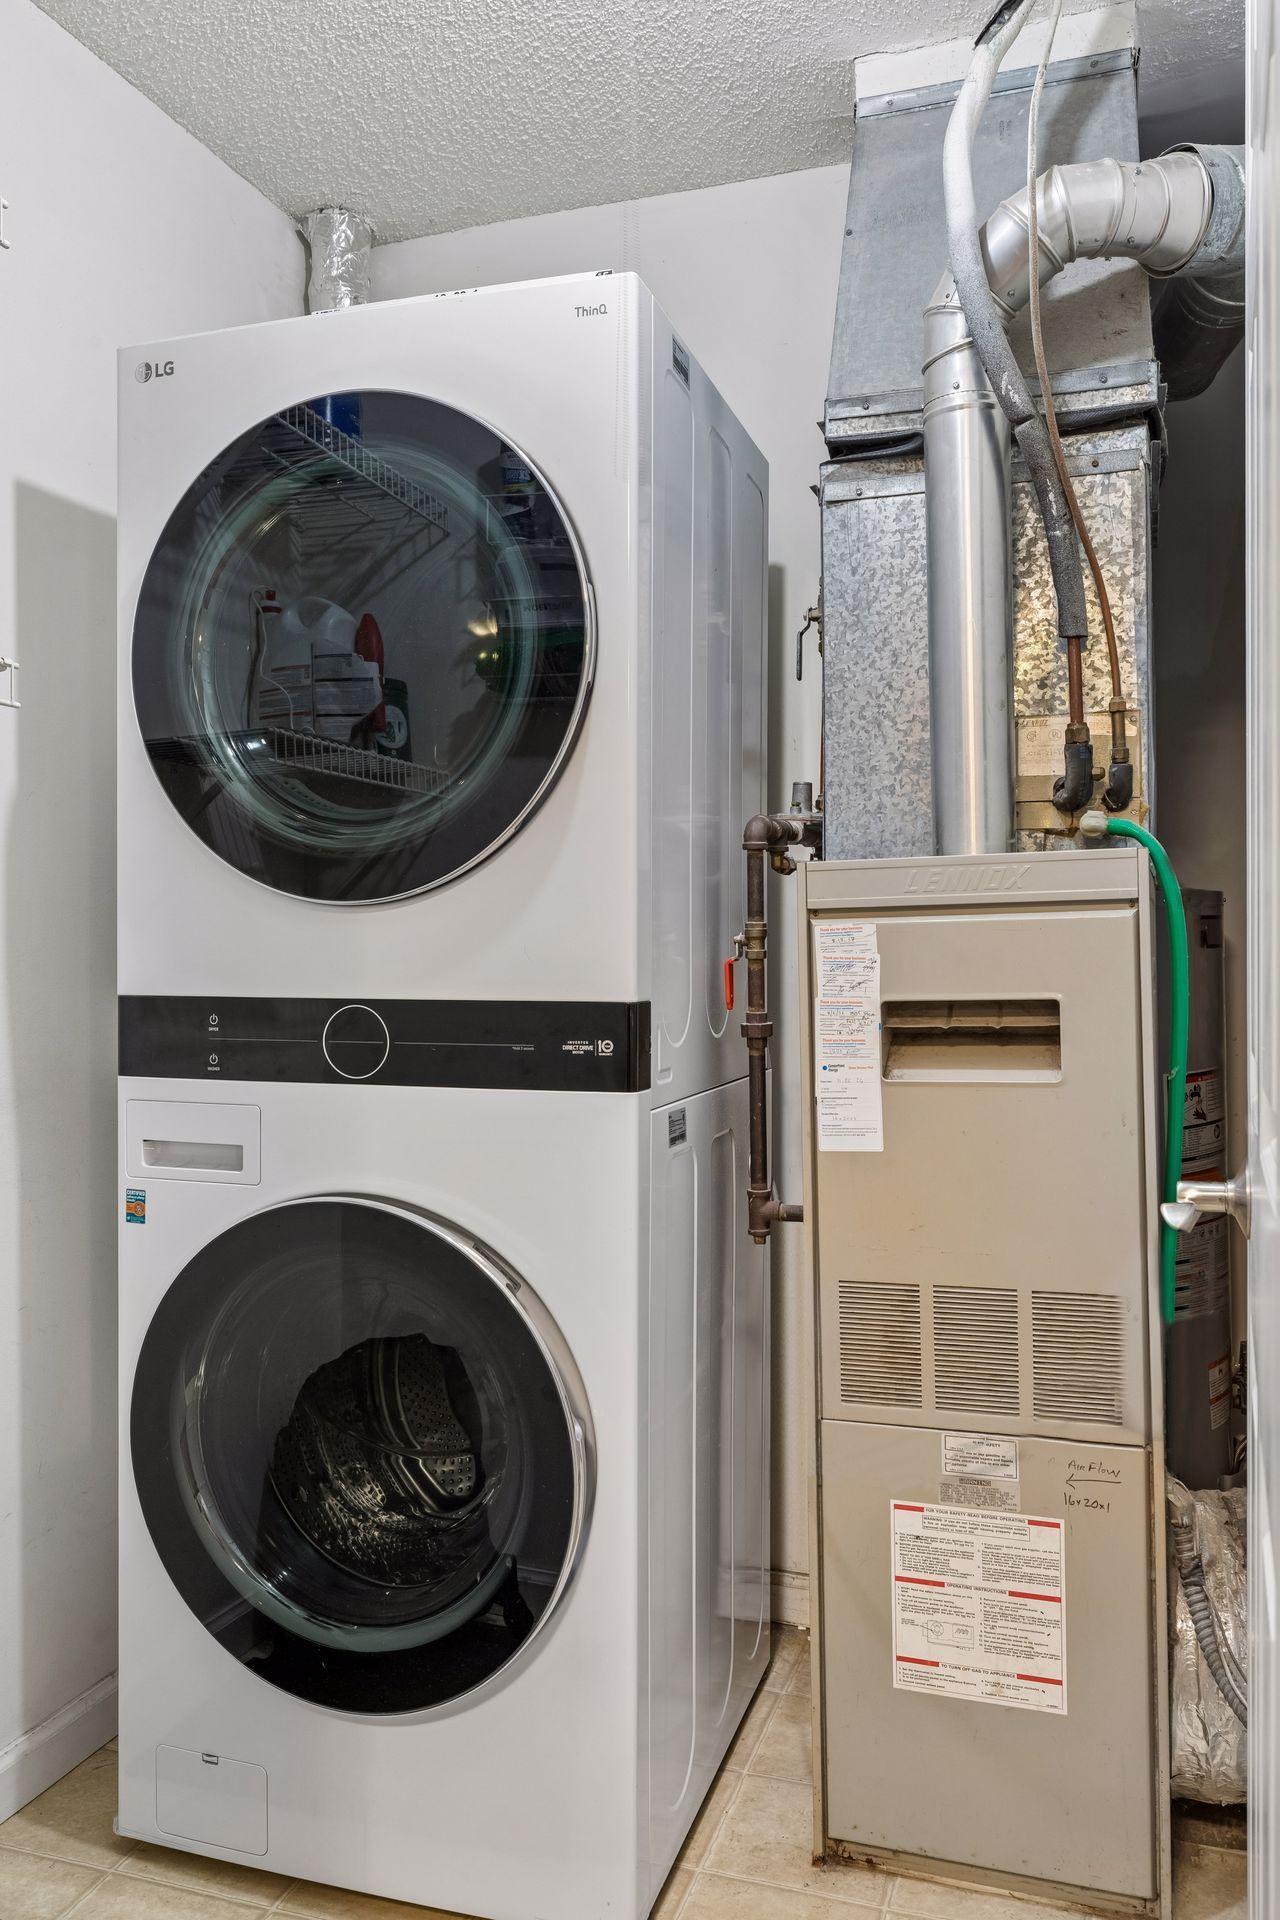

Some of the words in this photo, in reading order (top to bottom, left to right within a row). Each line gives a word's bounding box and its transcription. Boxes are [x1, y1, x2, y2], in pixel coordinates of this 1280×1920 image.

[575, 304, 607, 317] ThinQ
[155, 360, 174, 377] LG
[904, 865, 1032, 893] LENNOX
[947, 1582, 972, 1590] OPERATING
[974, 1586, 1006, 1594] INSTRUCTIONS
